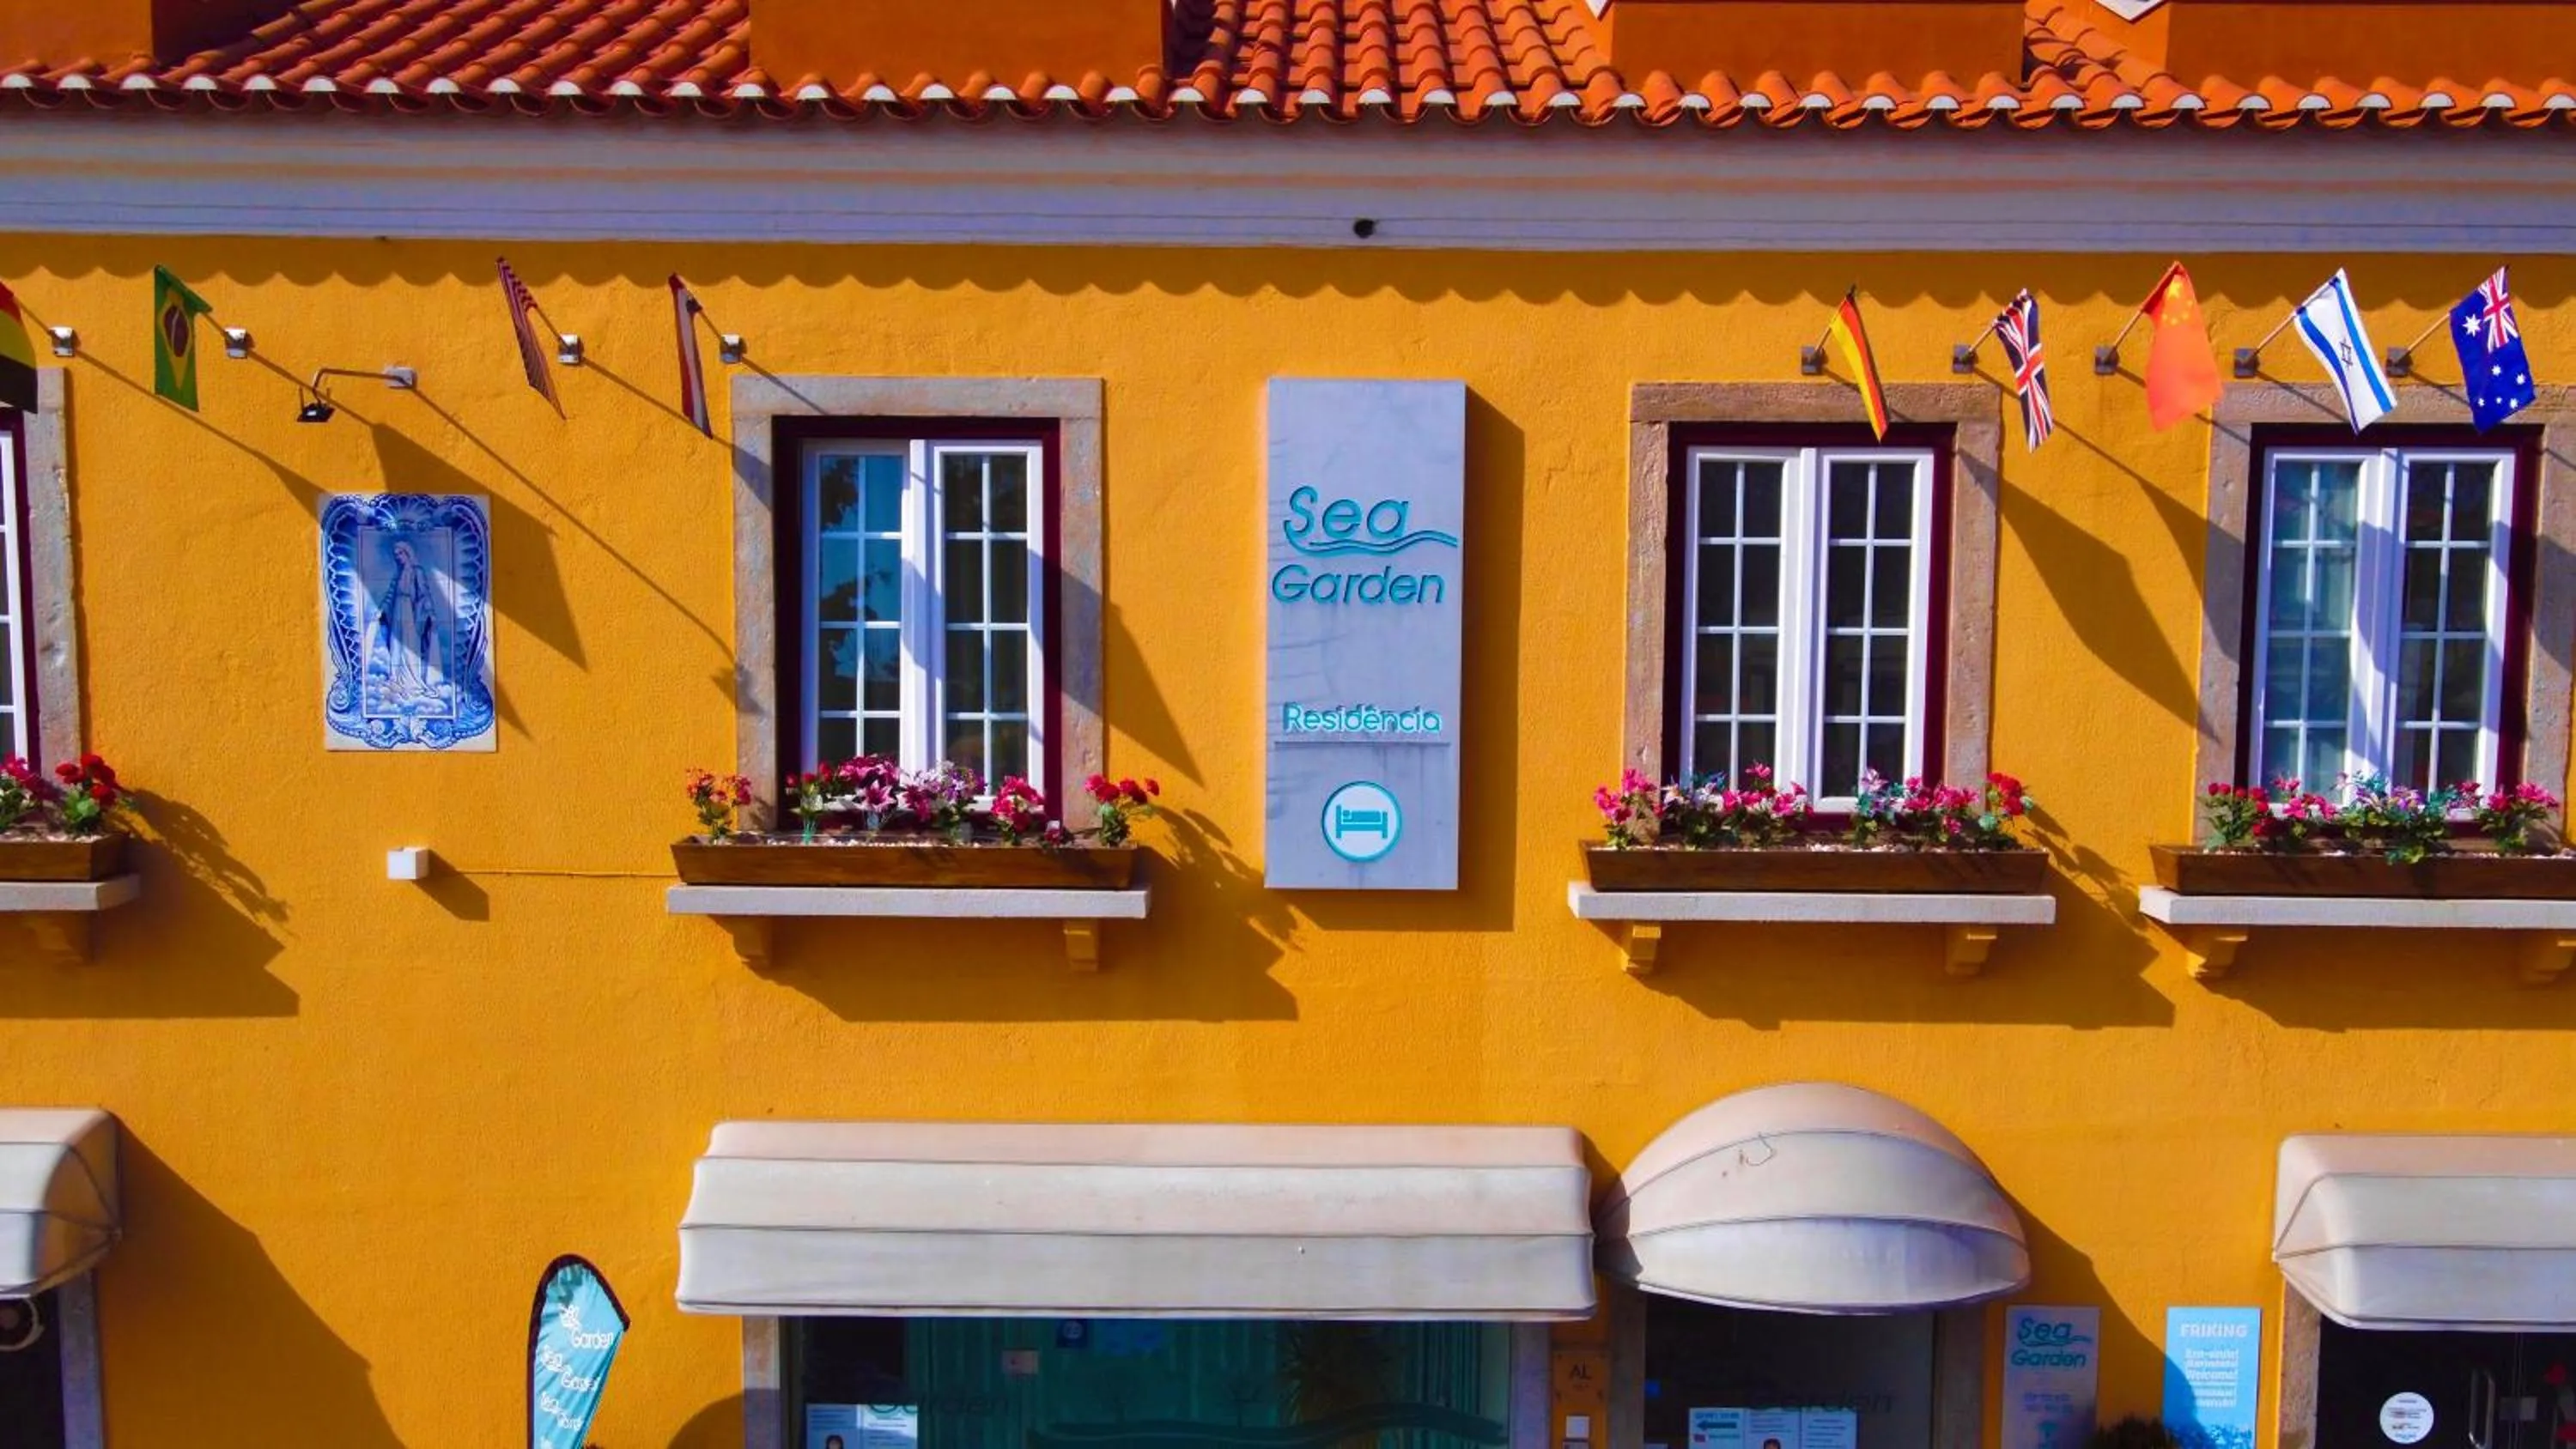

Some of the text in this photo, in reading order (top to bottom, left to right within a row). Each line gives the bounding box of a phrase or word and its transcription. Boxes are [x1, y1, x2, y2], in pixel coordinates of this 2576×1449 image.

[1284, 485, 1410, 549] Sea
[1272, 563, 1446, 604] Garden
[1283, 701, 1442, 732] Residência
[571, 1328, 614, 1349] Garden
[2018, 1316, 2073, 1342] Sea
[2179, 1323, 2248, 1337] FRIKING
[2010, 1349, 2087, 1367] Garden
